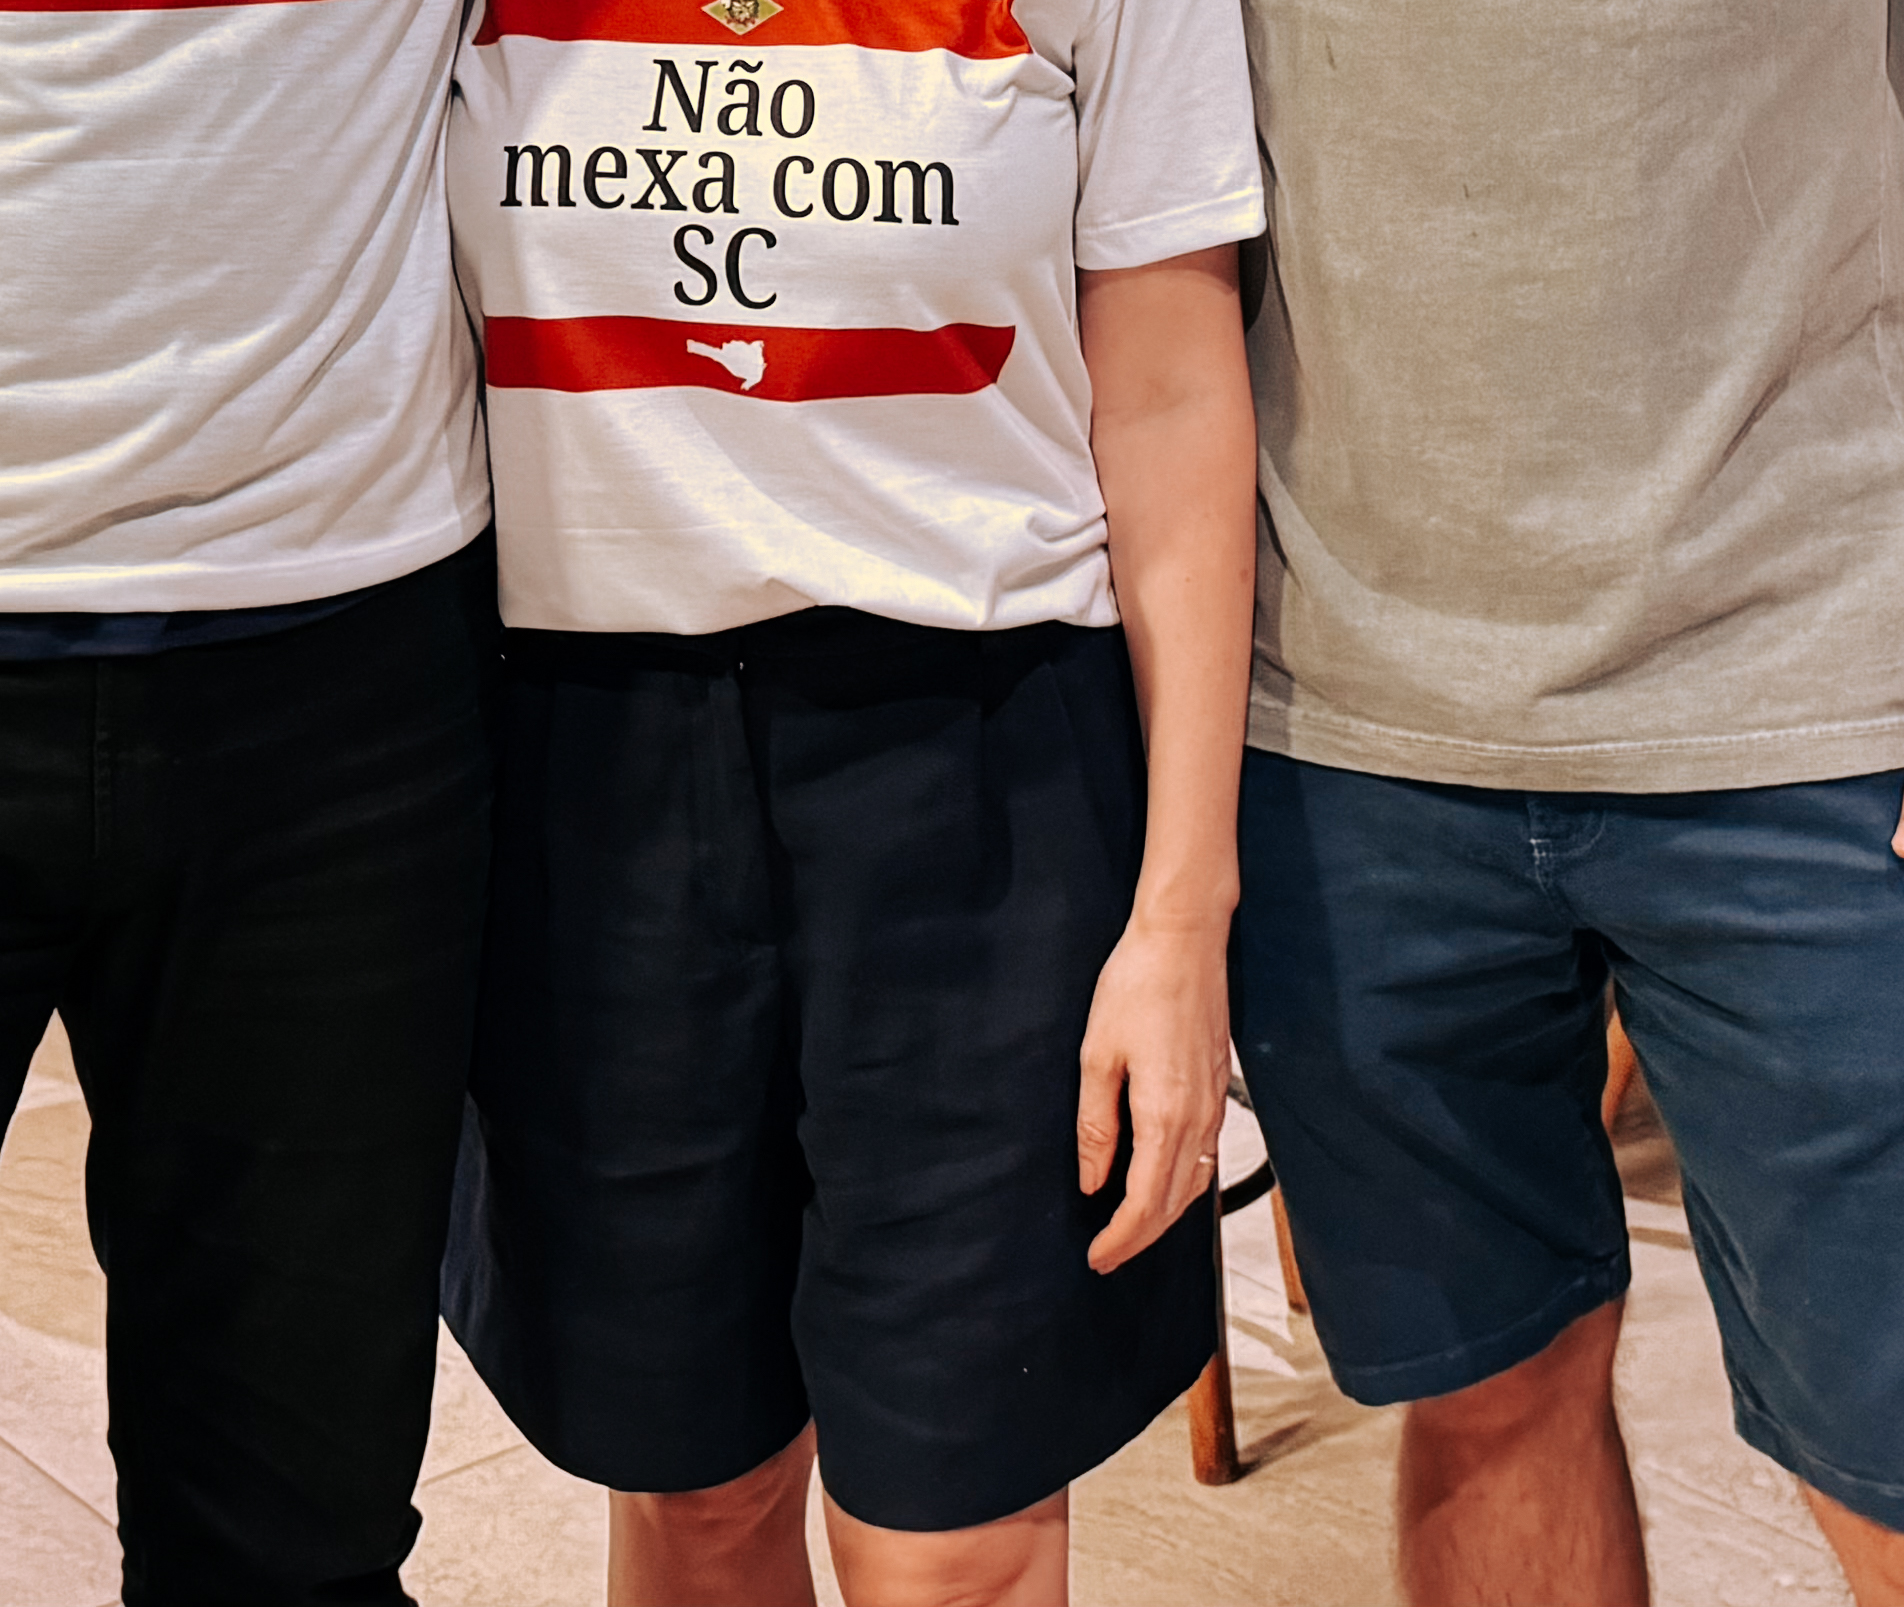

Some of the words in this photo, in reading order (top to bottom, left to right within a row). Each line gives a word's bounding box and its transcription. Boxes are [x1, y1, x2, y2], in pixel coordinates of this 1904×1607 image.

[643, 60, 814, 138] Não
[500, 145, 739, 213] mexa
[774, 156, 959, 225] com
[674, 225, 776, 309] SC
